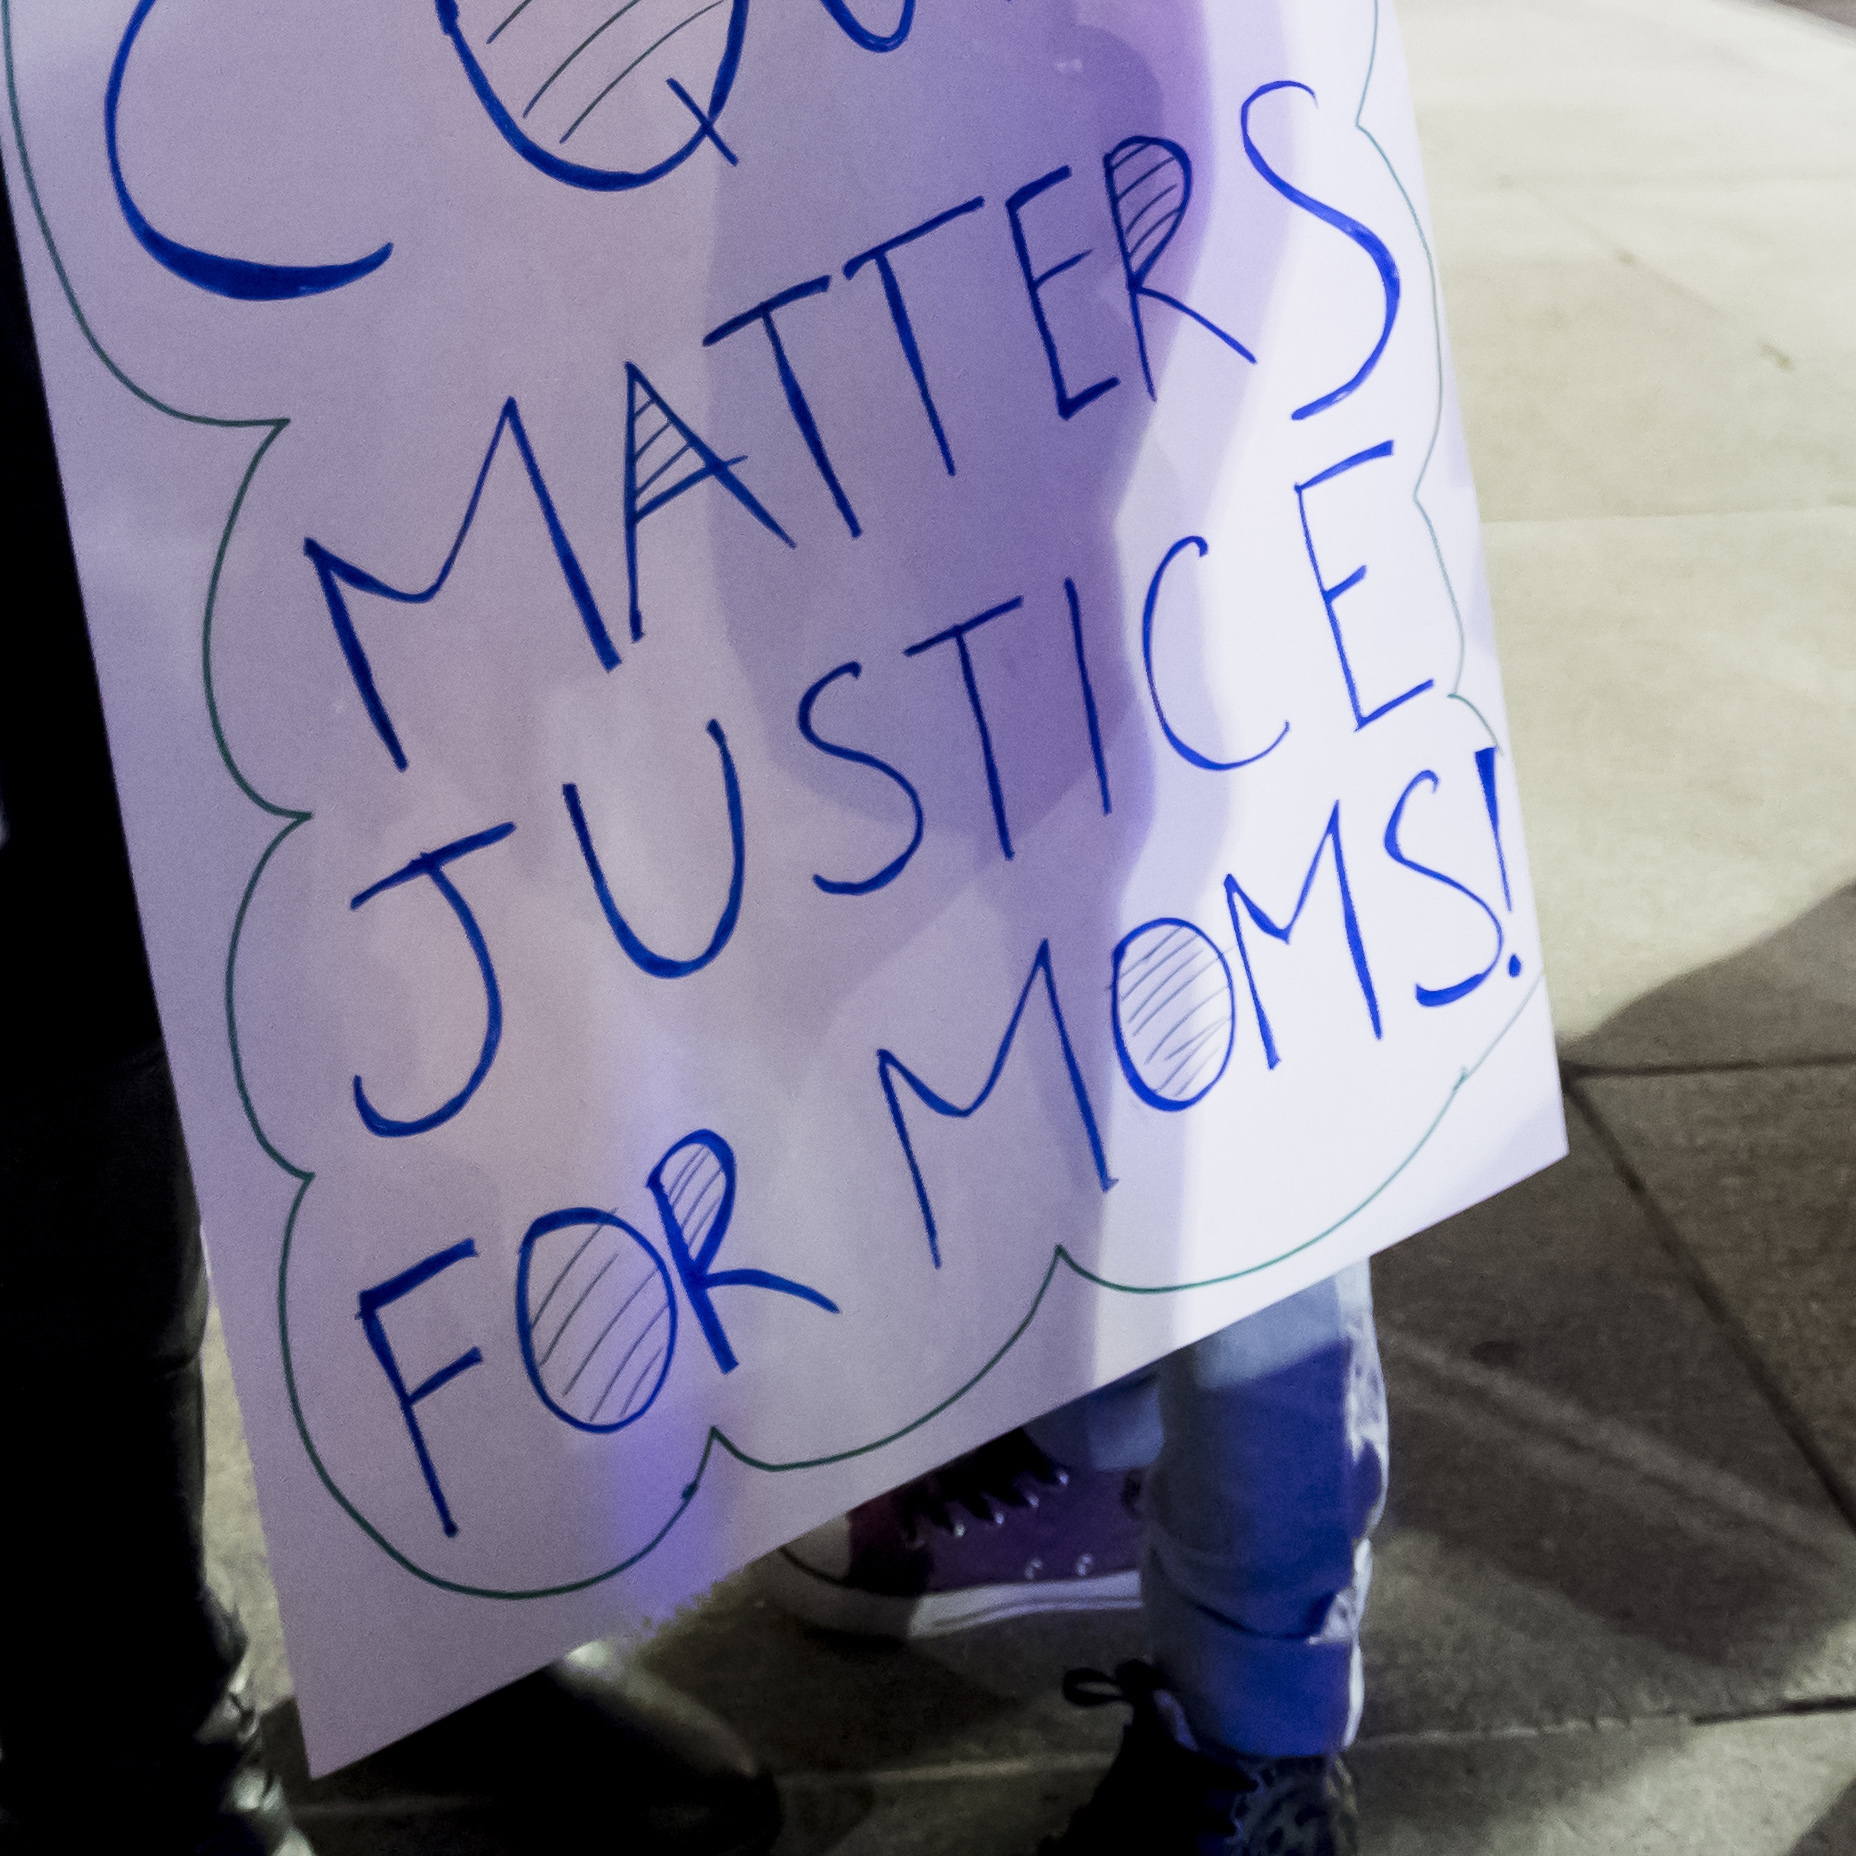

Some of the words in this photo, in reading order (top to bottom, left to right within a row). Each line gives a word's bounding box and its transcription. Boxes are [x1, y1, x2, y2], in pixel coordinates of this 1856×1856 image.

[305, 79, 1402, 769] MATTERS
[351, 438, 1434, 1138] JUSTICE
[358, 1127, 839, 1536] FOR
[876, 744, 1523, 1267] MOMS!
